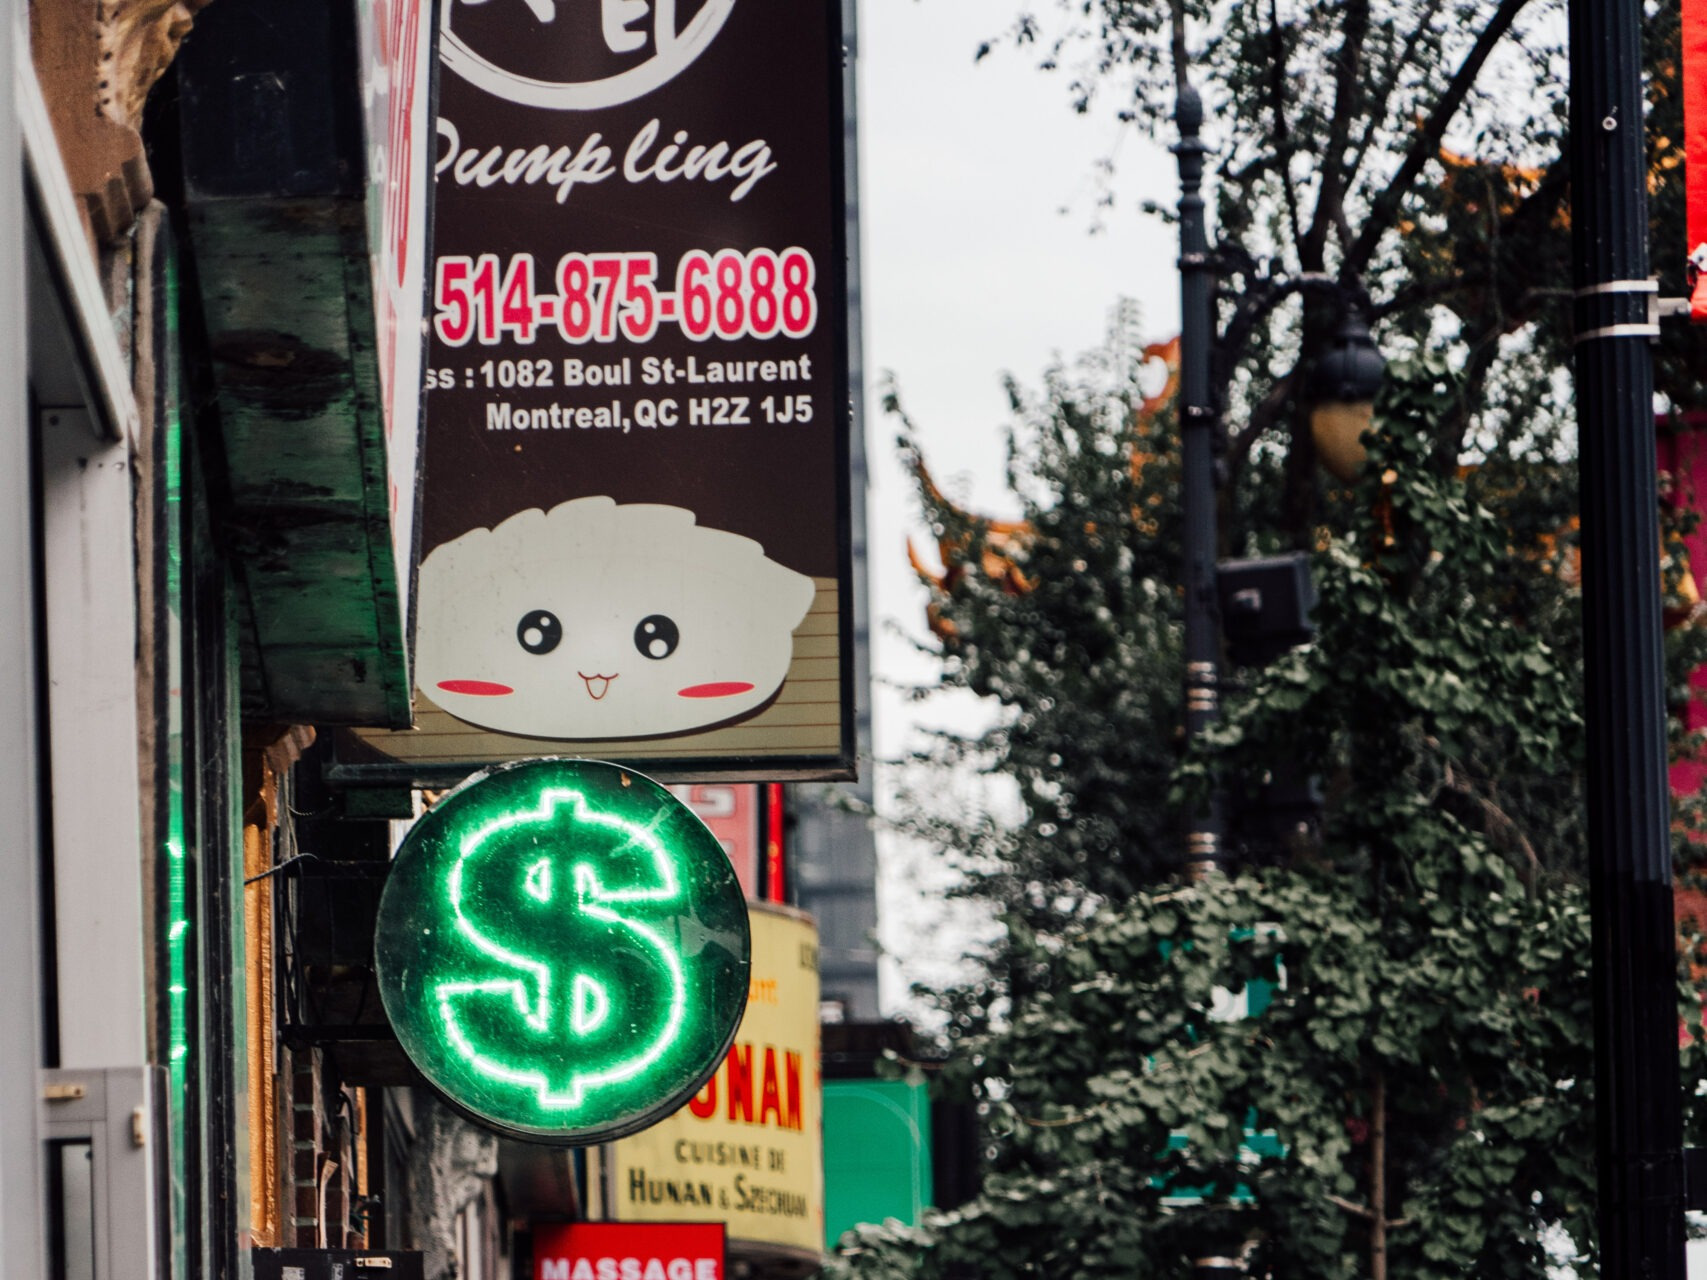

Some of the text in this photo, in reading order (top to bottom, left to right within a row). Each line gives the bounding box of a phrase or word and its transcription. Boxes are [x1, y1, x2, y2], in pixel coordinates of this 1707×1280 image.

[434, 247, 817, 347] 514-875-6888
[564, 358, 630, 386] Boul
[642, 355, 811, 384] St-Laurent
[690, 398, 750, 425] H2Z
[761, 396, 812, 423] 1J5
[674, 1138, 760, 1171] CUISINE
[628, 1167, 712, 1206] HUNAN
